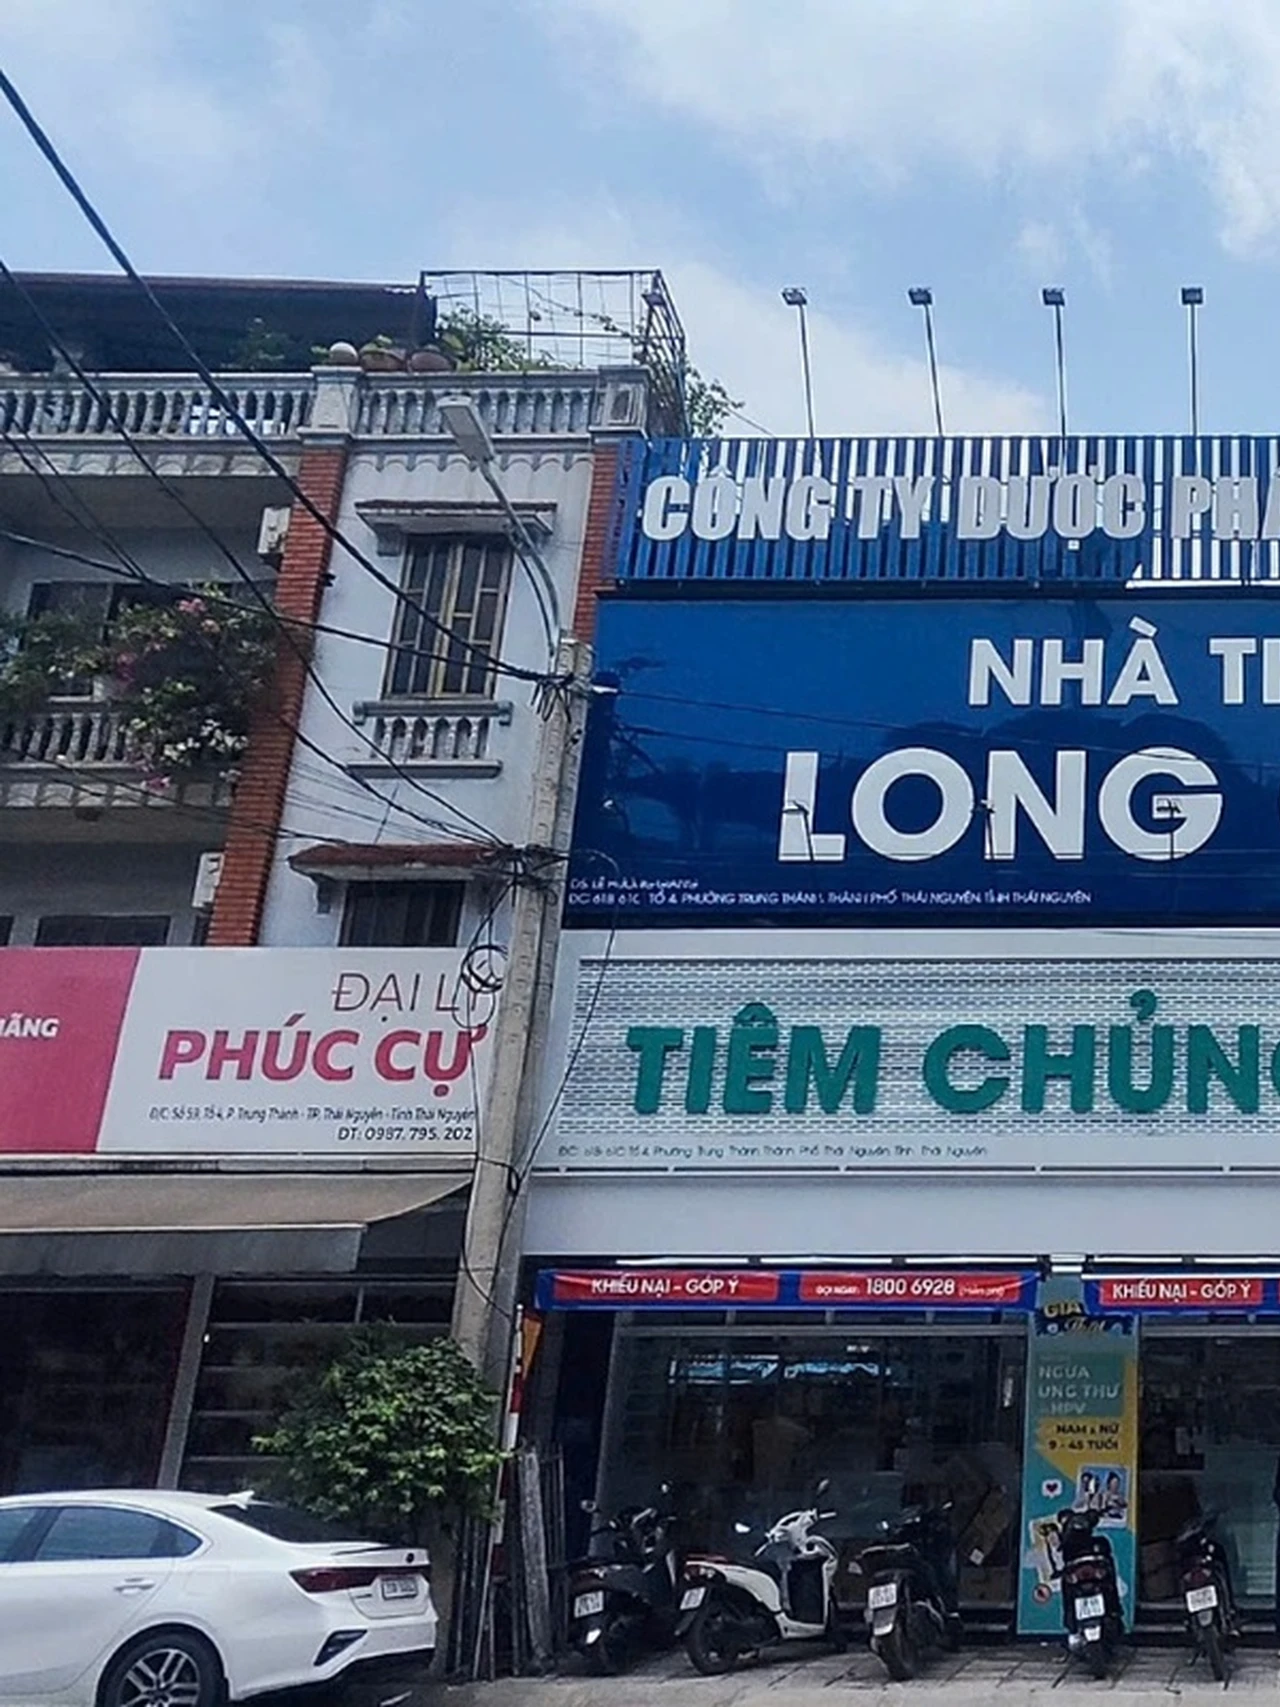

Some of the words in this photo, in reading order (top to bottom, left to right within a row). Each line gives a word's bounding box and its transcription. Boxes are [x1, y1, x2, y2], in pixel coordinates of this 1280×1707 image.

[641, 464, 832, 541] CÔNG
[853, 475, 936, 540] TY
[957, 465, 1147, 550] DƯỢC
[967, 616, 1180, 706] NHÀ
[778, 746, 1224, 863] LONG
[331, 972, 420, 1023] ĐẠI
[158, 1013, 361, 1081] PHÚC
[374, 1023, 488, 1097] CỰ
[626, 1001, 881, 1113] TIÊM
[444, 1127, 473, 1141] 202
[591, 1271, 639, 1294] KHIẾU
[641, 1277, 671, 1298] NẠI
[685, 1274, 724, 1294] GÓP
[728, 1274, 740, 1294] Ý
[866, 1278, 907, 1295] 1800
[909, 1278, 955, 1295] 6928
[1112, 1278, 1156, 1298] KHIẾU
[1159, 1284, 1187, 1302] NẠI
[1200, 1280, 1236, 1298] GÓP
[1240, 1280, 1251, 1298] Ý
